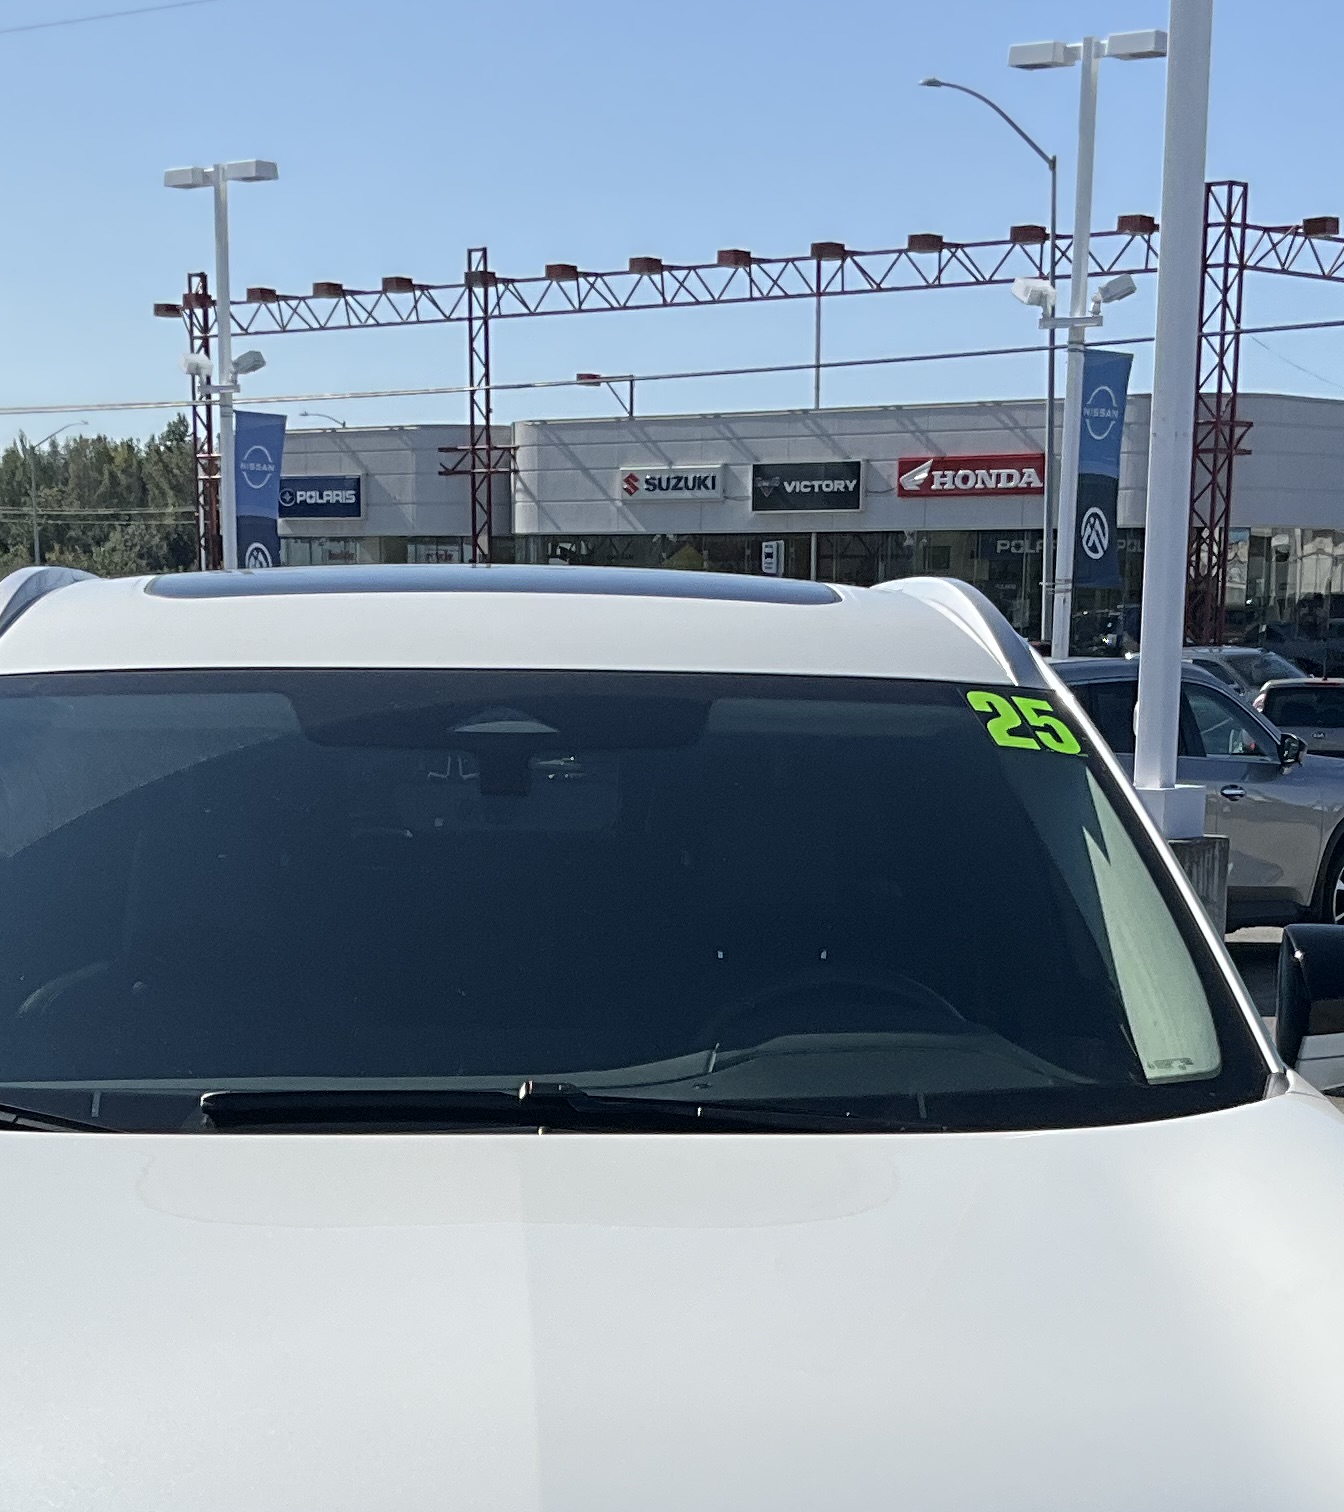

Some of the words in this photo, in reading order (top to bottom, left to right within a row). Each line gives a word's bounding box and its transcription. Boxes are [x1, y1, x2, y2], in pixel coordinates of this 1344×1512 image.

[1083, 407, 1119, 419] NISSAN
[240, 462, 275, 472] NISSAN
[644, 475, 716, 492] SUZUKI
[783, 479, 857, 493] VICTORY
[931, 468, 1044, 490] HONDA
[296, 490, 356, 504] POLARIS
[966, 690, 1081, 755] 25
